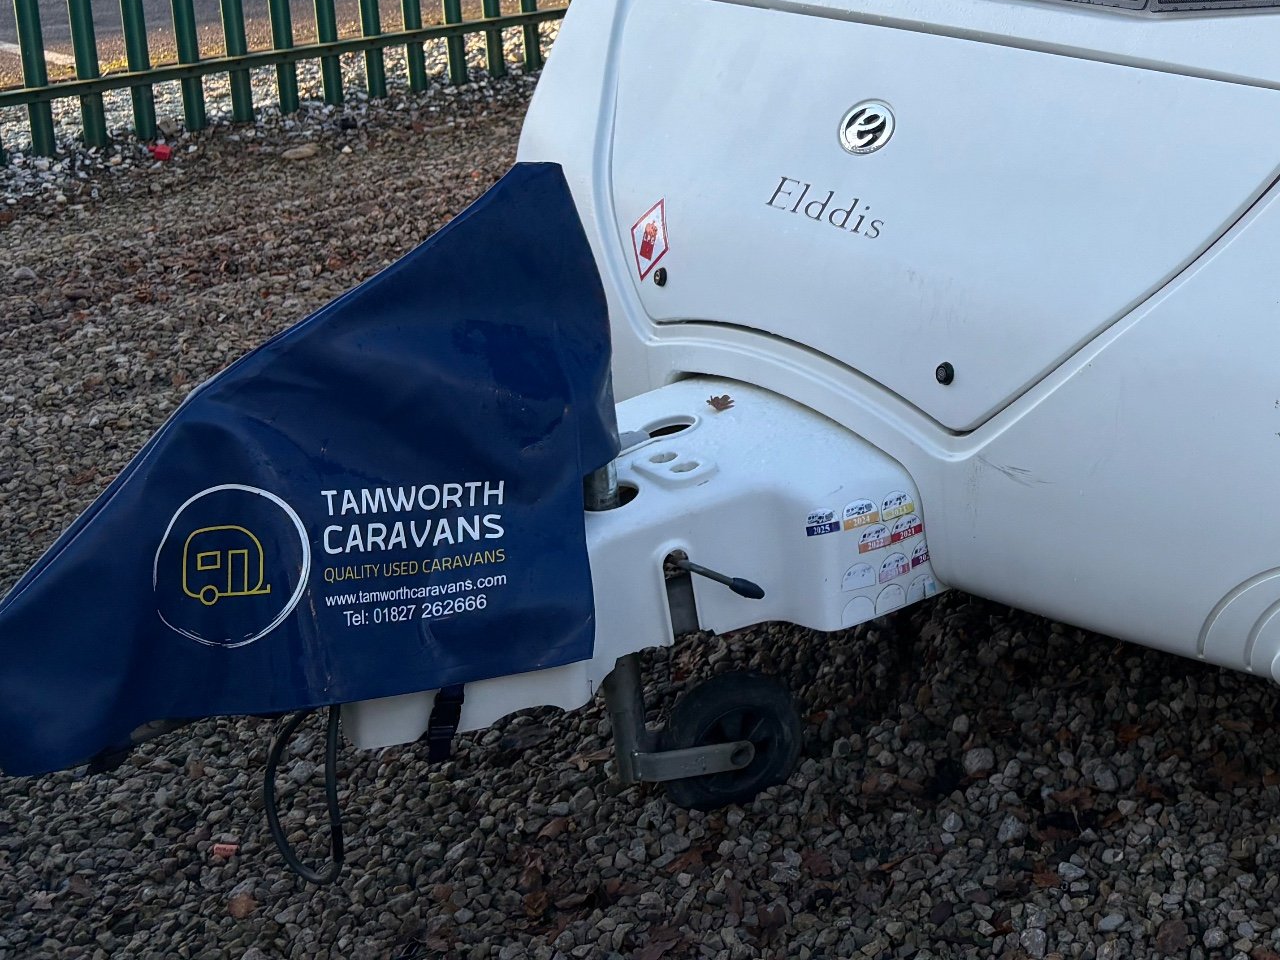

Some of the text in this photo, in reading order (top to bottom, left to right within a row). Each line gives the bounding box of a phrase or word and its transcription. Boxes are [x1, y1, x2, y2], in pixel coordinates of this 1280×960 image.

[765, 176, 885, 239] Elddis
[320, 480, 505, 516] TAMWORTH
[323, 514, 505, 555] CARAVANS
[813, 524, 831, 535] 2025
[324, 548, 506, 584] QUALITY USED CARAVANS
[325, 574, 507, 607] www.tamworthcaravans.com
[343, 594, 487, 627] Tel: 01827 262666
